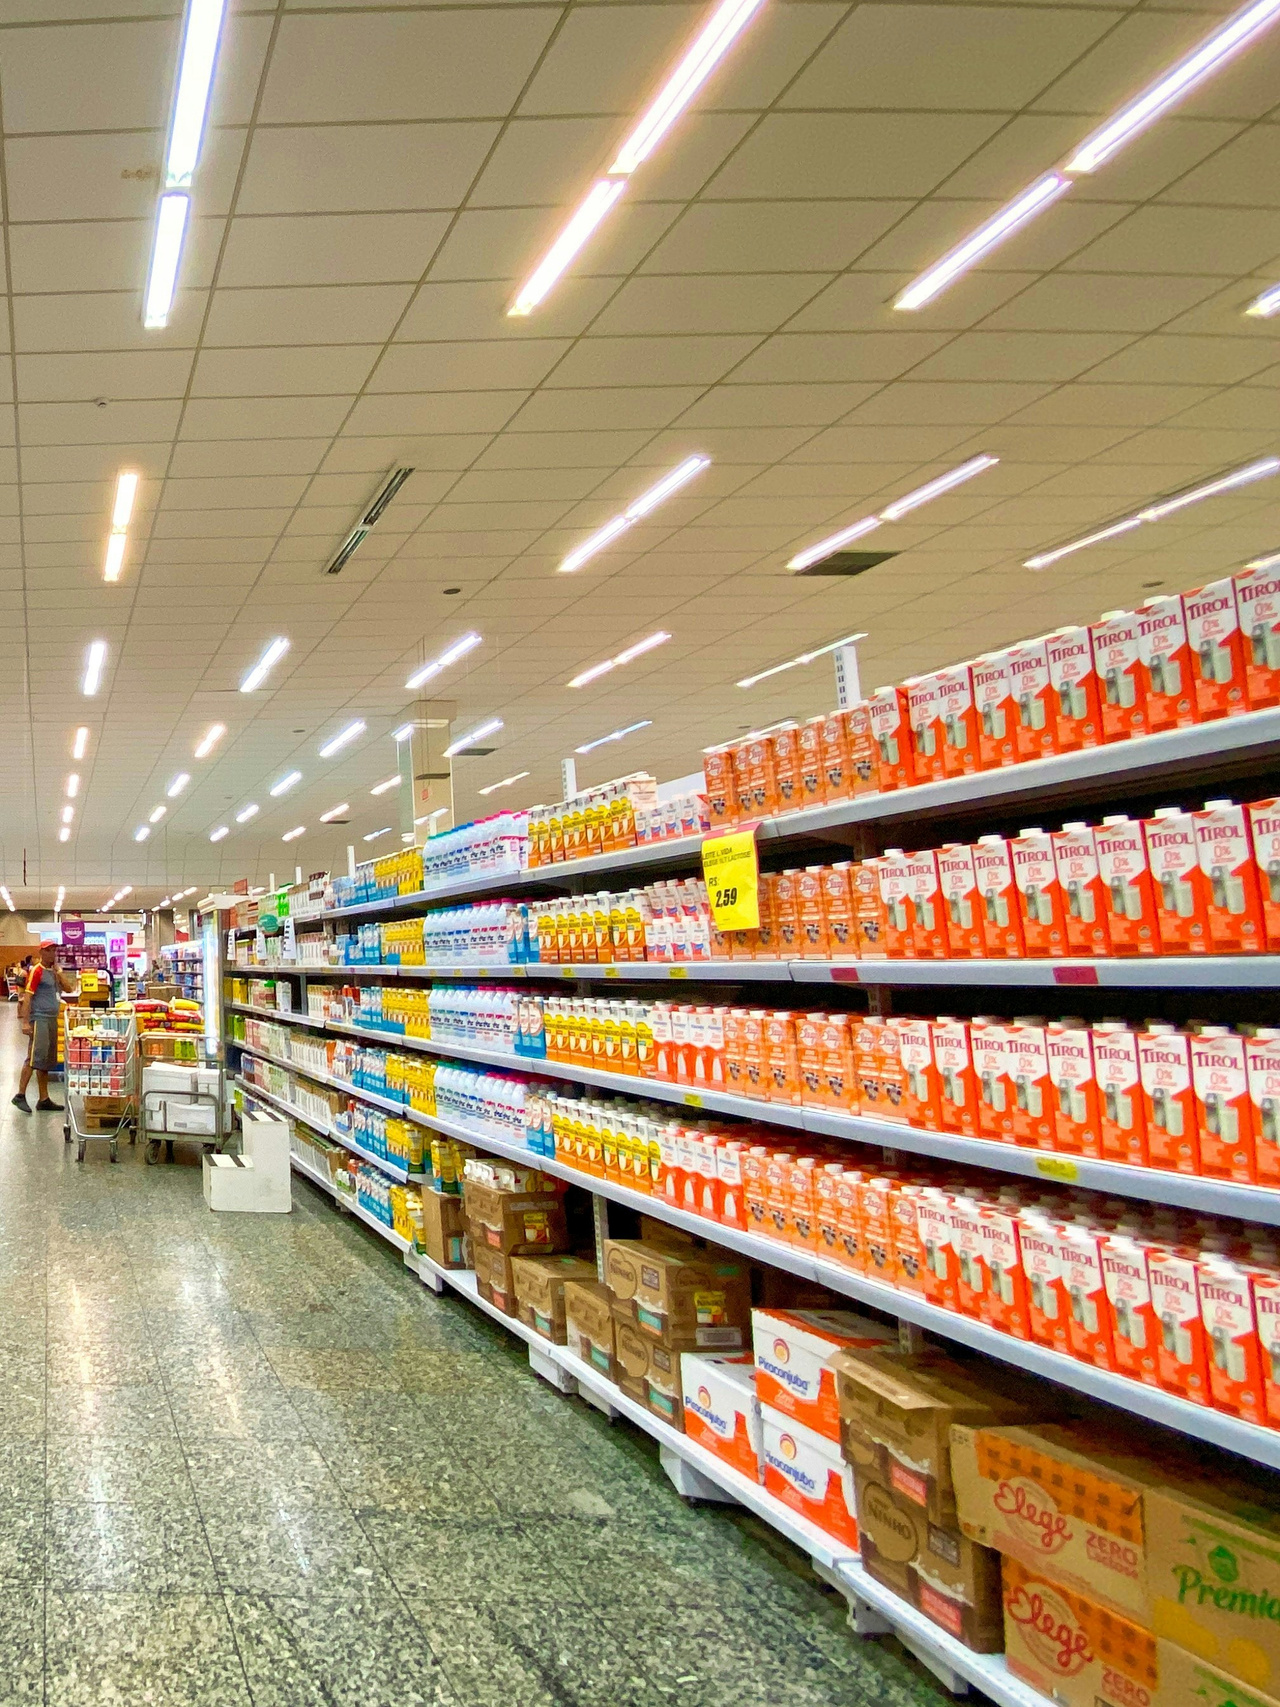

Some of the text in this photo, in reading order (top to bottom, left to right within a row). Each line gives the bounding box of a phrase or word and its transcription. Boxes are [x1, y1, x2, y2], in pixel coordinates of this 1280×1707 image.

[1187, 597, 1233, 620] TIROL
[1138, 614, 1181, 636] TIROL
[1202, 619, 1220, 632] 0%
[1094, 628, 1137, 651] TIROL
[1152, 635, 1168, 648] 0%
[1049, 644, 1088, 663] TIROL
[1010, 657, 1047, 675] TIROL
[974, 669, 1007, 687] TIROL
[937, 681, 968, 698] TIROL
[910, 691, 937, 707] TIROL
[870, 703, 897, 718] TIROL
[1148, 832, 1194, 849] TIROL
[1197, 825, 1243, 843] TIROL
[1056, 845, 1094, 859] TIROL
[1097, 839, 1141, 855] TIROL
[1213, 845, 1231, 858] 0%
[975, 856, 1008, 870] TIROL
[1014, 850, 1052, 864] TIROL
[1113, 857, 1129, 869] 0%
[1164, 851, 1181, 864] 0%
[880, 868, 906, 879] TIROL
[906, 864, 934, 877] TIROL
[940, 859, 972, 873] TIROL
[715, 887, 737, 908] 2,59
[900, 1033, 928, 1047] TIROL
[933, 1034, 965, 1050] TIROL
[973, 1037, 1005, 1053] TIROL
[1006, 1039, 1044, 1056] TIROL
[1048, 1042, 1088, 1059] TIROL
[1095, 1045, 1135, 1063] TIROL
[1141, 1049, 1186, 1066] TIROL
[1193, 1051, 1243, 1070] TIROL
[1156, 1068, 1173, 1081] 0%
[1210, 1072, 1228, 1085] 0%
[918, 1206, 949, 1225] TIROL
[950, 1215, 980, 1234] TIROL
[980, 1225, 1013, 1246] TIROL
[1021, 1236, 1058, 1257] TIROL
[1059, 1246, 1097, 1268] TIROL
[1103, 1258, 1145, 1281] TIROL
[1151, 1269, 1194, 1295] TIROL
[1201, 1283, 1248, 1309] TIROL
[758, 1355, 810, 1391] Piracanjuba
[684, 1395, 728, 1431] Piracanjuba
[1085, 1529, 1138, 1566] ZERO
